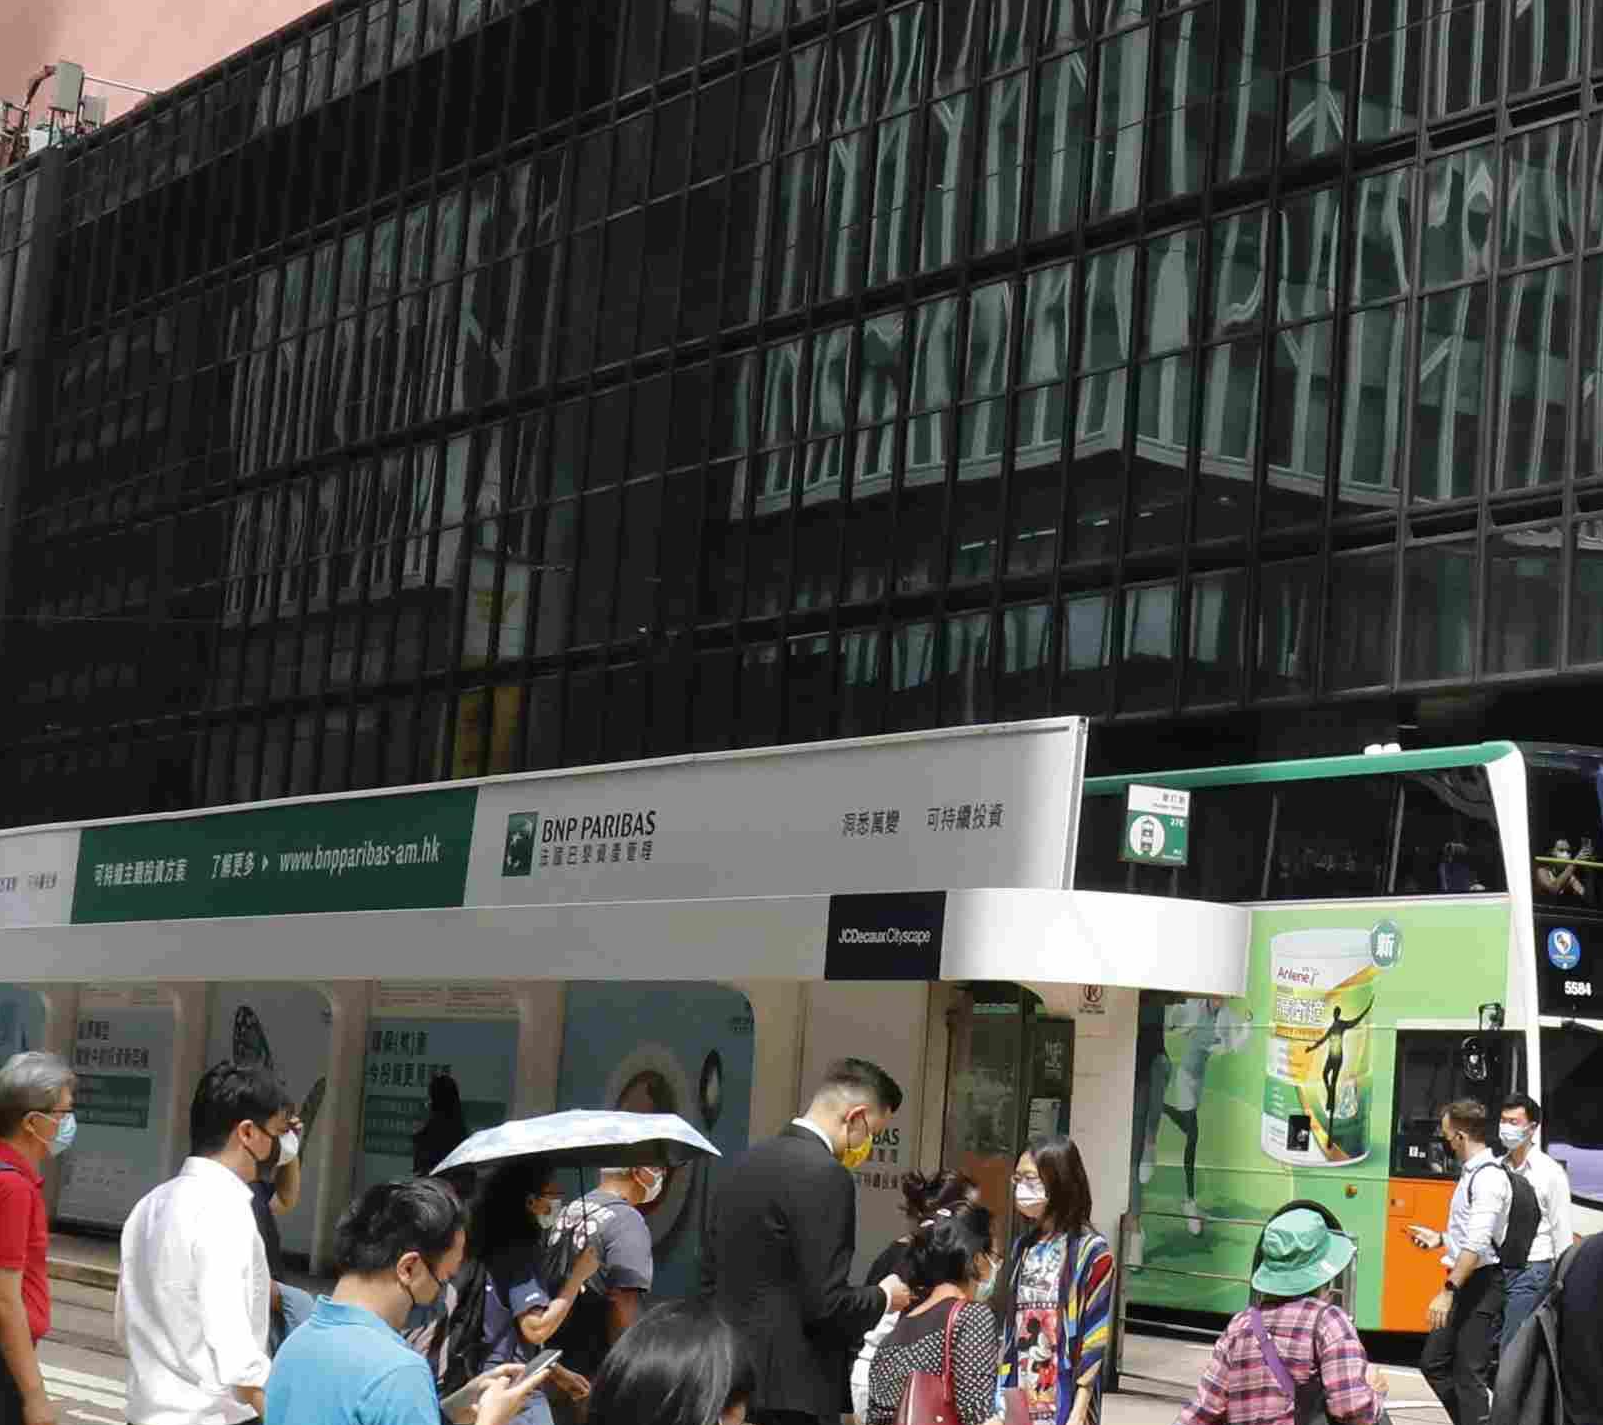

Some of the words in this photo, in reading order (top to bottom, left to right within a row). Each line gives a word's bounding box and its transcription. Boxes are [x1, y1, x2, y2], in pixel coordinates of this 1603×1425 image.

[541, 817, 578, 843] BNP
[581, 810, 657, 840] PARIBAS
[279, 834, 442, 877] www.bnpparibas-am.hk
[1564, 980, 1592, 997] 5584
